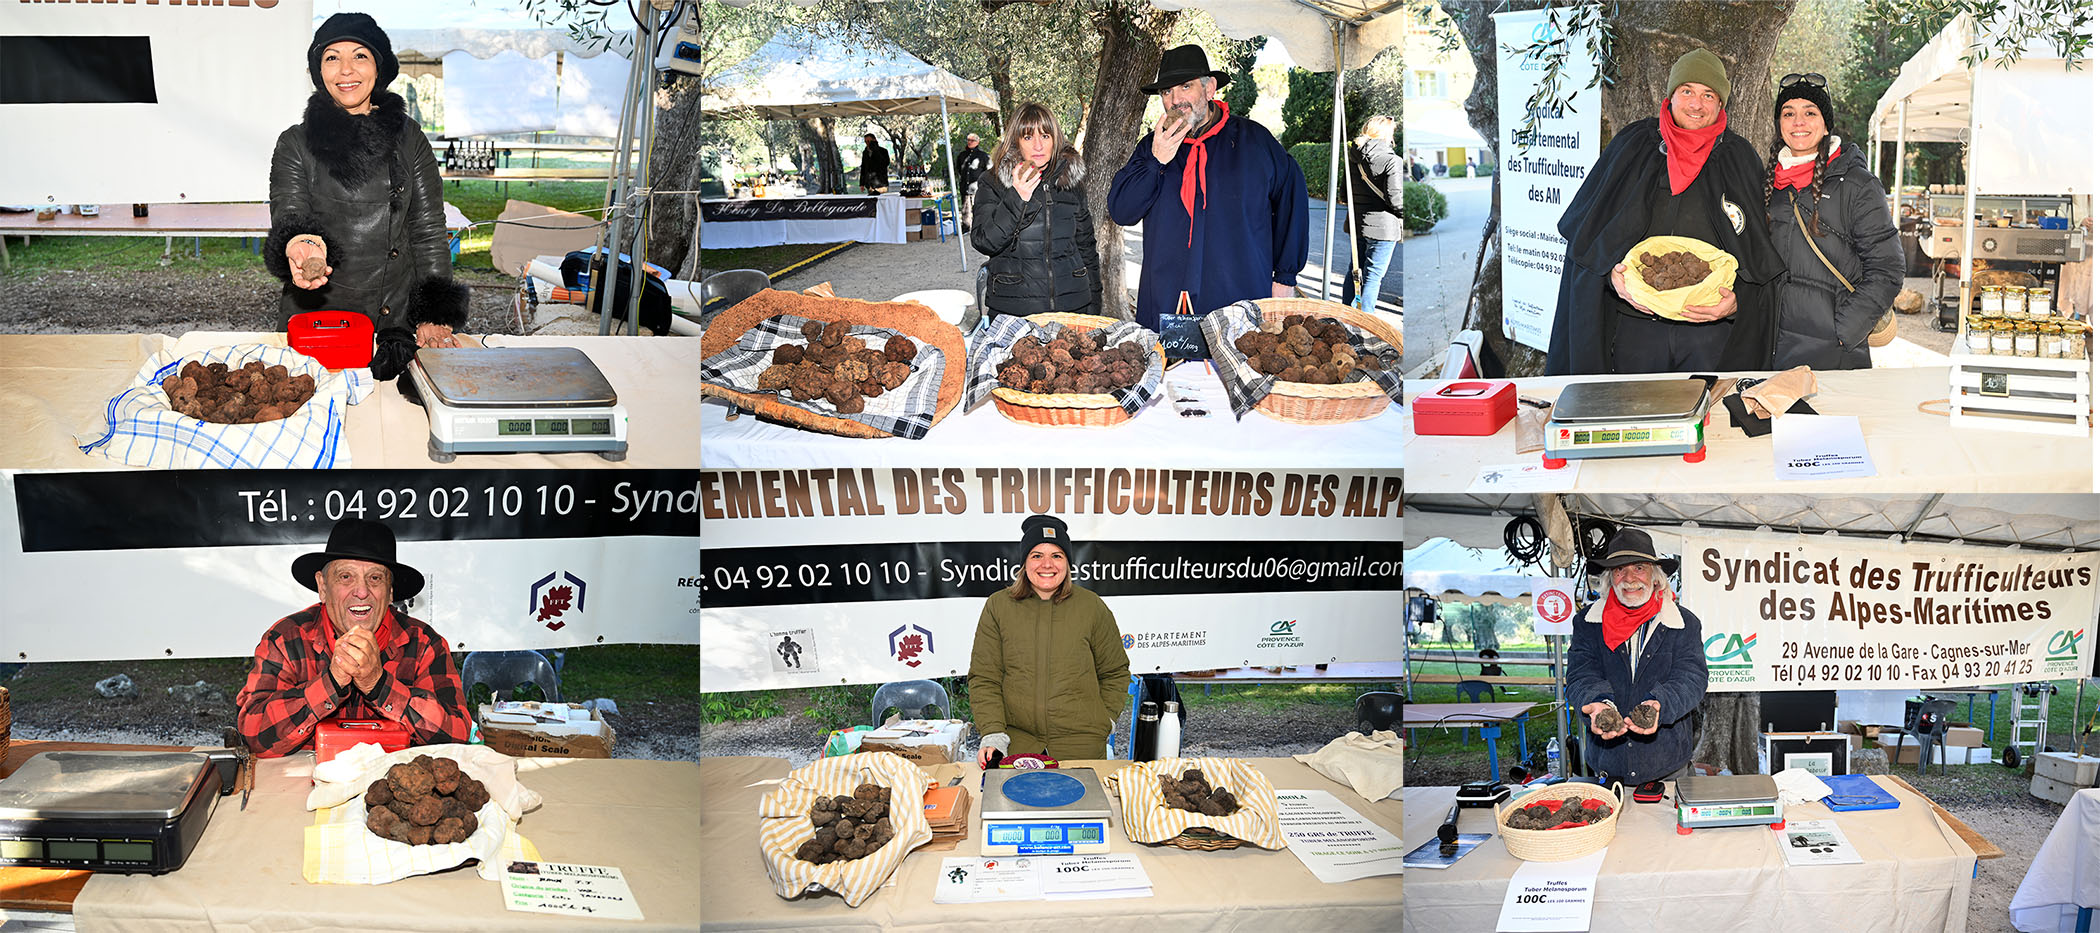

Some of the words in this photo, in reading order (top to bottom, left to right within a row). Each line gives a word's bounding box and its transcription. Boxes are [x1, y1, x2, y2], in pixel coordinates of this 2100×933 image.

[1507, 155, 1522, 172] des
[1522, 157, 1585, 179] Trufficulteurs
[1528, 184, 1544, 202] des
[1545, 187, 1561, 204] AM
[712, 203, 760, 217] Henry
[1519, 230, 1537, 239] social
[1540, 232, 1559, 243] Mairie
[1522, 248, 1541, 257] matin
[1541, 250, 1549, 259] 04
[1550, 252, 1558, 260] 92
[1536, 262, 1545, 271] 04
[1545, 263, 1553, 272] 93
[1553, 266, 1561, 275] 20
[238, 488, 297, 522] Tél.
[324, 489, 367, 520] 04
[376, 488, 418, 519] 92
[428, 487, 470, 518] 02
[483, 485, 523, 517] 10
[536, 484, 575, 515] 10
[611, 482, 700, 521] Synd
[893, 468, 967, 516] DES
[976, 468, 1275, 517] TRUFFICULTEURS
[1280, 473, 1340, 518] DES
[714, 566, 750, 591] 04
[756, 565, 792, 589] 92
[798, 563, 833, 587] 02
[840, 561, 872, 586] 10
[880, 560, 911, 584] 10
[1701, 547, 1840, 592] Syndicat
[1849, 558, 1901, 592] des
[1911, 562, 2091, 593] Trufficulteurs
[1759, 589, 1816, 621] des
[1828, 590, 2052, 630] Alpes-Maritimes
[1137, 630, 1207, 641] DÉPARTEMENT
[1150, 638, 1206, 648] ALPES-MARITIMES
[1782, 642, 1798, 659] 29
[1803, 641, 1854, 659] Avenue
[1859, 643, 1874, 659] de
[1877, 643, 1888, 658] la
[1891, 643, 1919, 660] Gare
[1931, 639, 2031, 662] Cagnes-sur-Mer
[1771, 664, 1793, 682] Tél
[1797, 664, 1816, 681] 04
[1821, 664, 1840, 681] 92
[1844, 664, 1863, 681] 02
[1867, 664, 1882, 681] 10
[1886, 664, 1901, 681] 10
[1912, 664, 1938, 681] Fax
[1941, 663, 1960, 680] 04
[1964, 662, 1981, 679] 93
[1984, 660, 2001, 677] 20
[2004, 660, 2018, 676] 41
[2018, 659, 2033, 675] 25
[541, 745, 570, 755] Scale
